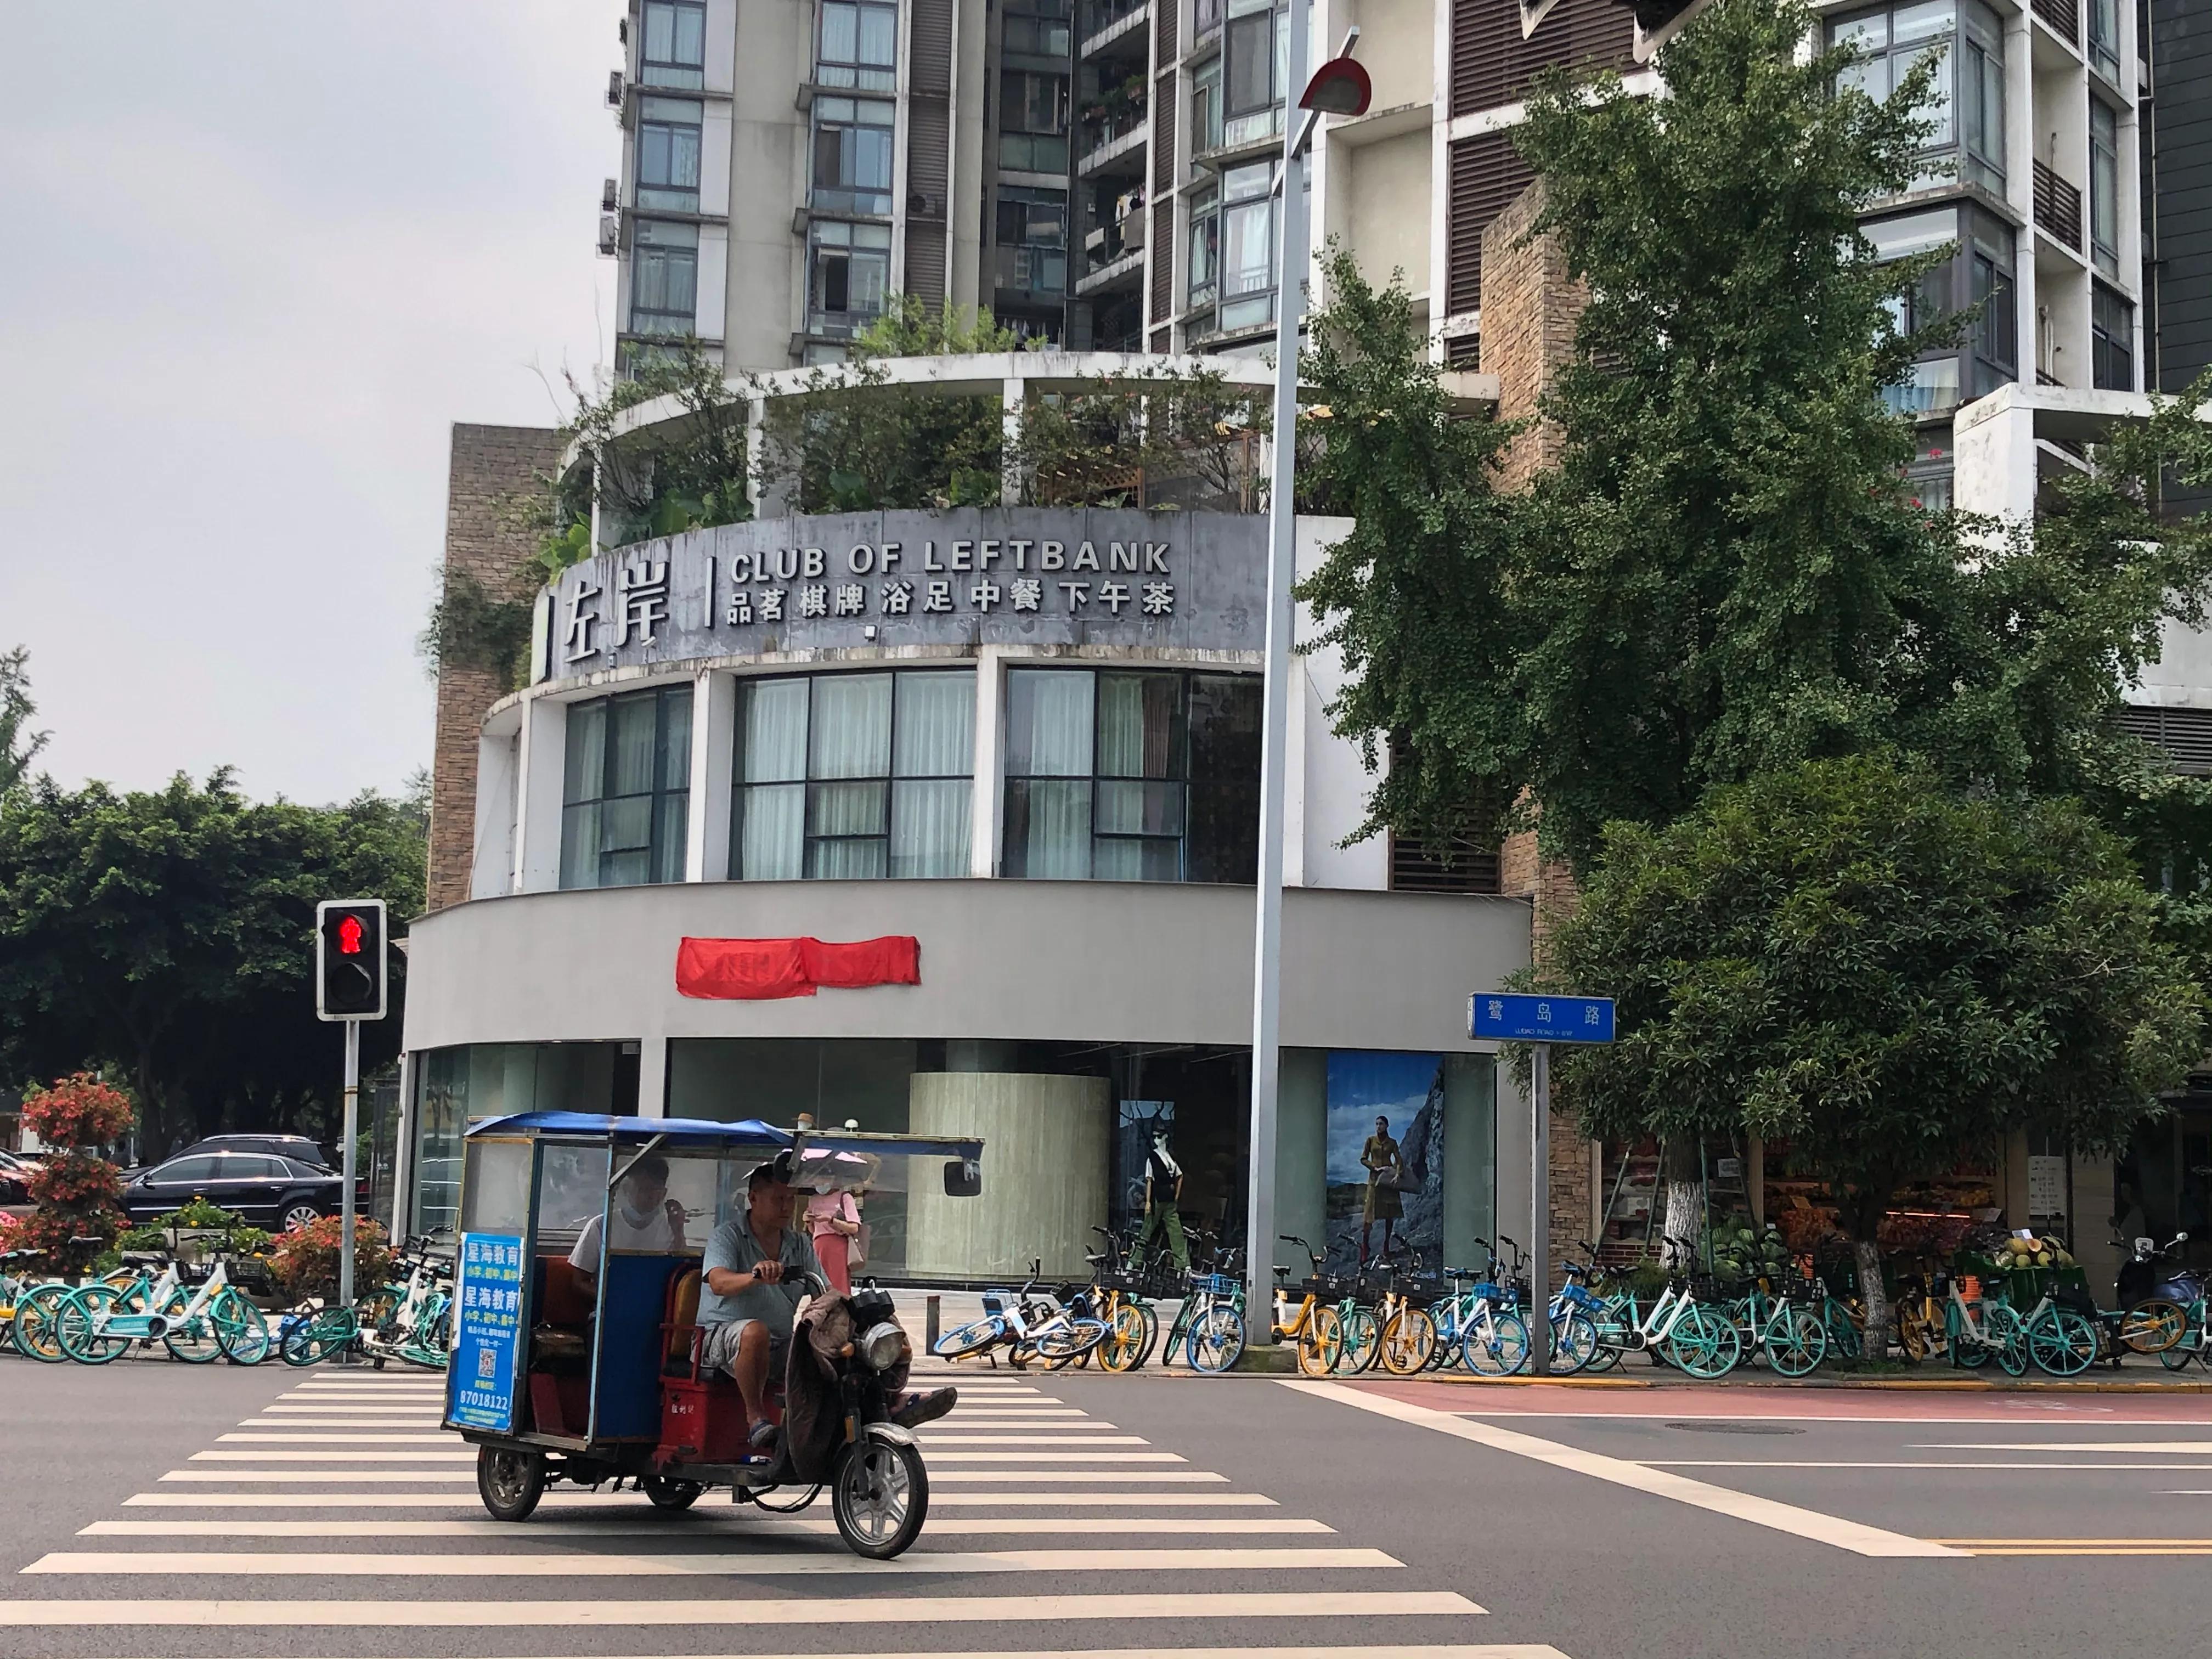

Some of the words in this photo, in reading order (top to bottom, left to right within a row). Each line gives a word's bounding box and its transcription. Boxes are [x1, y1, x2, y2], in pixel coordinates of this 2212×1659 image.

[731, 548, 824, 583] CLUB
[848, 543, 900, 574] OF
[924, 540, 1170, 572] LEFTBANK
[565, 562, 666, 663] 左岸
[727, 589, 785, 624] 品茗
[800, 584, 865, 617] 棋牌
[882, 581, 953, 613] 浴足
[970, 578, 1041, 612] 中餐
[1058, 580, 1173, 614] 下午茶
[1488, 1000, 1599, 1025] 鹭岛路
[467, 1243, 518, 1266] 星海教育
[464, 1285, 518, 1312] 星海教育
[460, 1390, 508, 1410] 87018122
